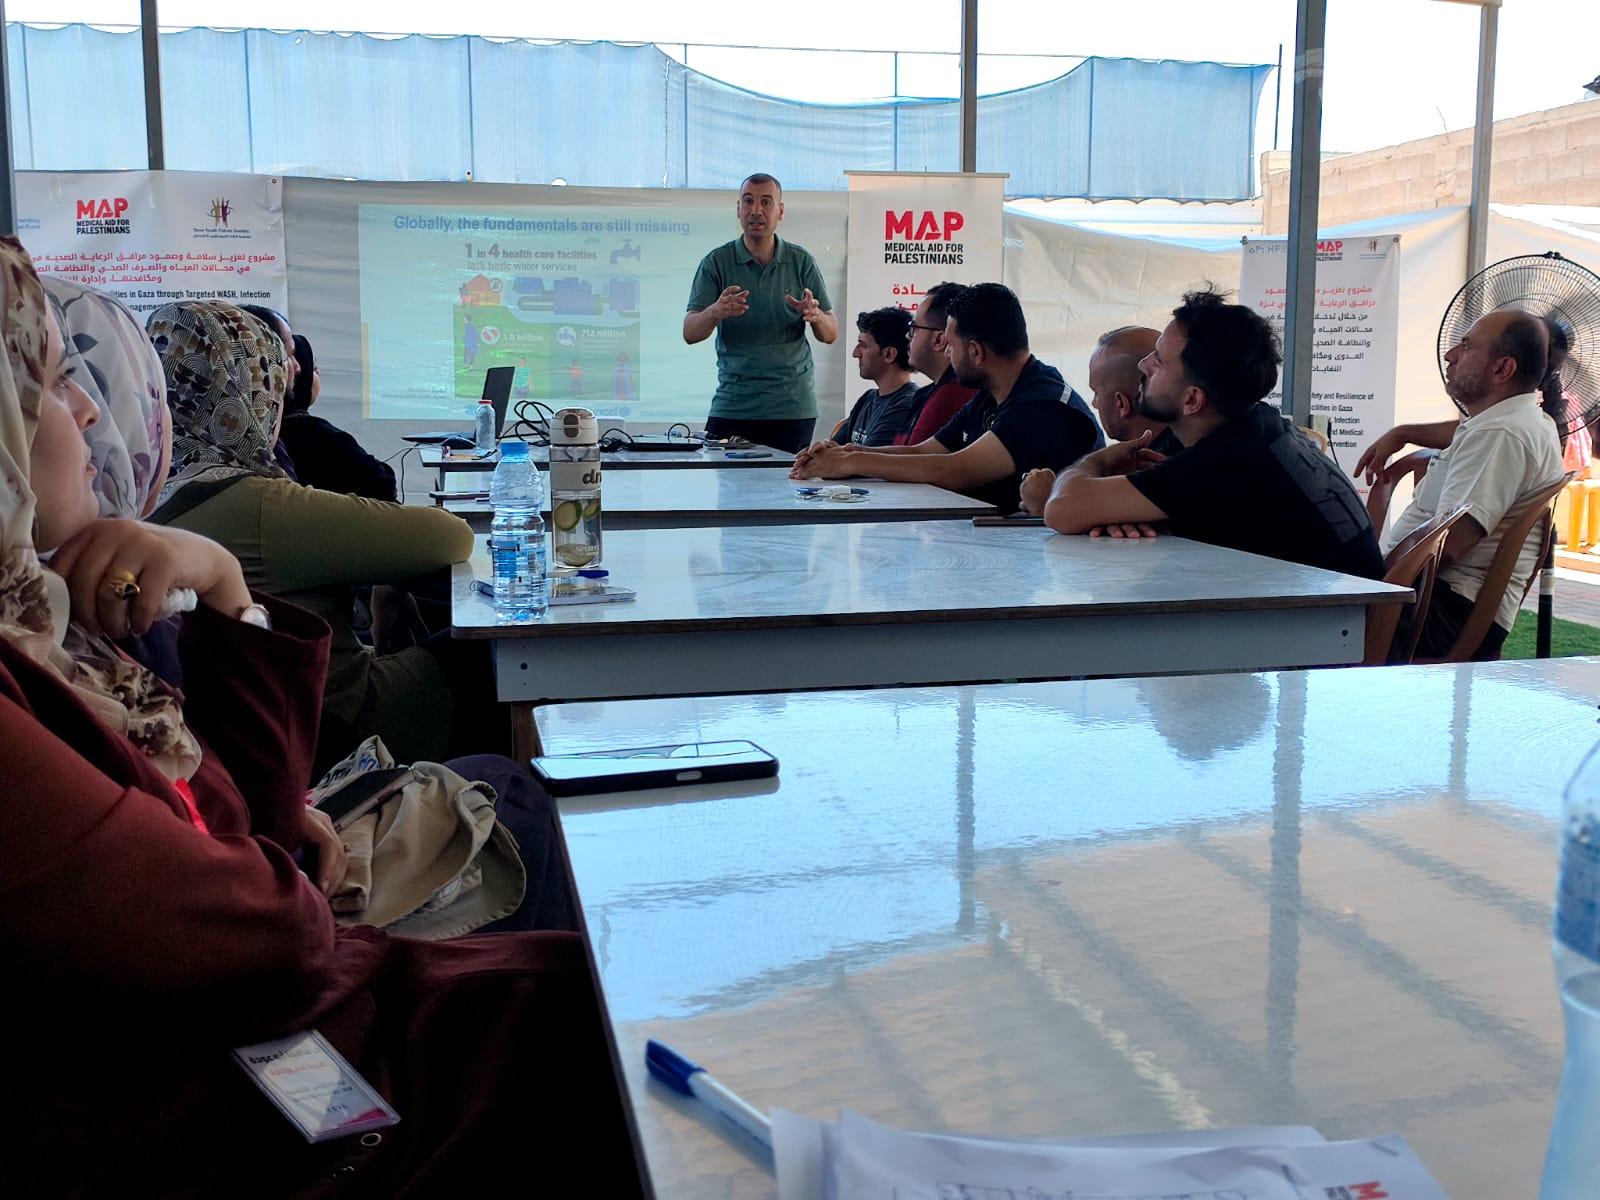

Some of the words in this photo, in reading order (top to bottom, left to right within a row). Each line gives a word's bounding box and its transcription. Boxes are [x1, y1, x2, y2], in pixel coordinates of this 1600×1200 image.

[76, 197, 129, 220] MAP
[394, 215, 454, 232] Globally,
[457, 217, 480, 230] the
[483, 217, 578, 232] fundamentals
[581, 221, 603, 232] are
[606, 219, 631, 232] still
[635, 219, 690, 236] missing
[885, 210, 964, 241] MAP
[76, 226, 131, 235] PALESTINIANS
[884, 243, 925, 252] MEDICAL
[927, 243, 943, 252] AID
[945, 243, 964, 253] FOR
[1316, 239, 1344, 252] MAP
[464, 242, 473, 258] 1
[477, 249, 486, 258] in
[488, 242, 500, 258] 4
[502, 249, 533, 259] health
[534, 250, 555, 259] care
[557, 249, 598, 260] facilities
[46, 253, 77, 263] الصحية
[80, 252, 113, 262] الرعاية
[116, 251, 147, 262] مرافق
[149, 253, 184, 262] وصمود
[186, 252, 217, 261] سلامة
[219, 253, 246, 263] تعزيز
[248, 252, 276, 263] مشروع
[884, 253, 964, 265] PALESTINIANS
[54, 264, 95, 273] والنظافة
[98, 264, 128, 273] الصحي
[131, 264, 166, 273] والصرف
[169, 264, 199, 273] المياه
[201, 264, 234, 273] مجالات
[237, 265, 251, 274] في
[467, 260, 485, 270] lack
[488, 261, 511, 270] basic
[514, 262, 539, 271] water
[541, 262, 578, 272] services
[129, 290, 136, 298] in
[137, 290, 155, 298] Gaza
[156, 290, 184, 299] through
[185, 290, 215, 299] Targeted
[216, 290, 239, 299] WASH,
[240, 290, 271, 298] Infection
[1346, 285, 1372, 296] مشروع
[1313, 312, 1336, 320] تدخلا
[1318, 326, 1343, 334] المياه
[1337, 339, 1371, 348] والنظافة
[1311, 392, 1323, 400] fety
[1323, 392, 1335, 400] and
[1335, 392, 1366, 400] Resilience
[1334, 416, 1360, 424] Infection
[1339, 428, 1364, 436] Medical
